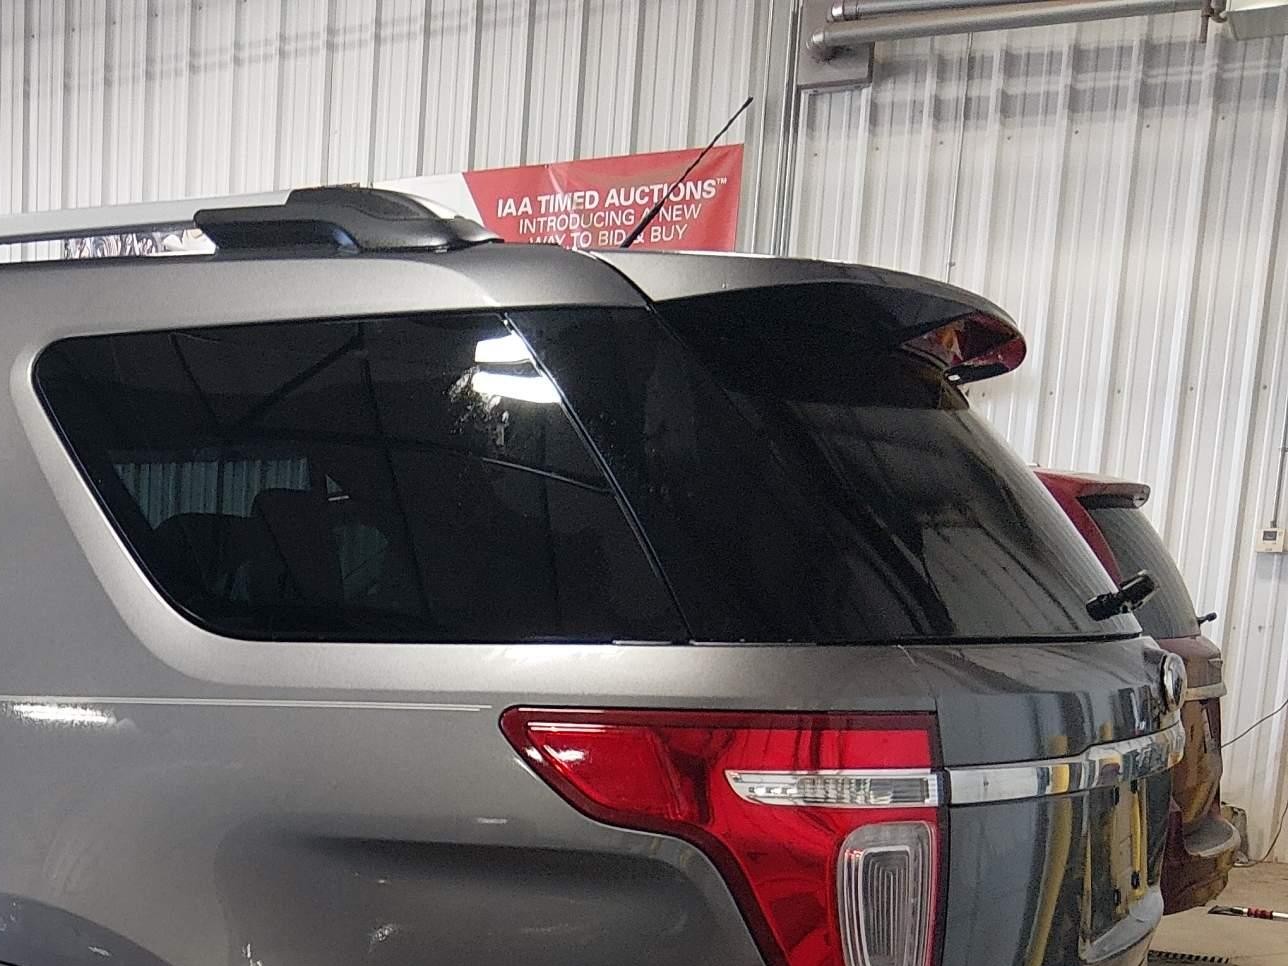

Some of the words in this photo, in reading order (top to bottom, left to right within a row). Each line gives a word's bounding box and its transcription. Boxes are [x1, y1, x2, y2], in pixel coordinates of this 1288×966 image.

[497, 197, 533, 218] IAA
[537, 190, 599, 214] TIMED
[519, 208, 635, 235] INTRODUCING
[659, 203, 702, 222] NEW
[570, 231, 592, 249] TO
[598, 229, 626, 246] BID
[650, 223, 688, 243] BUY
